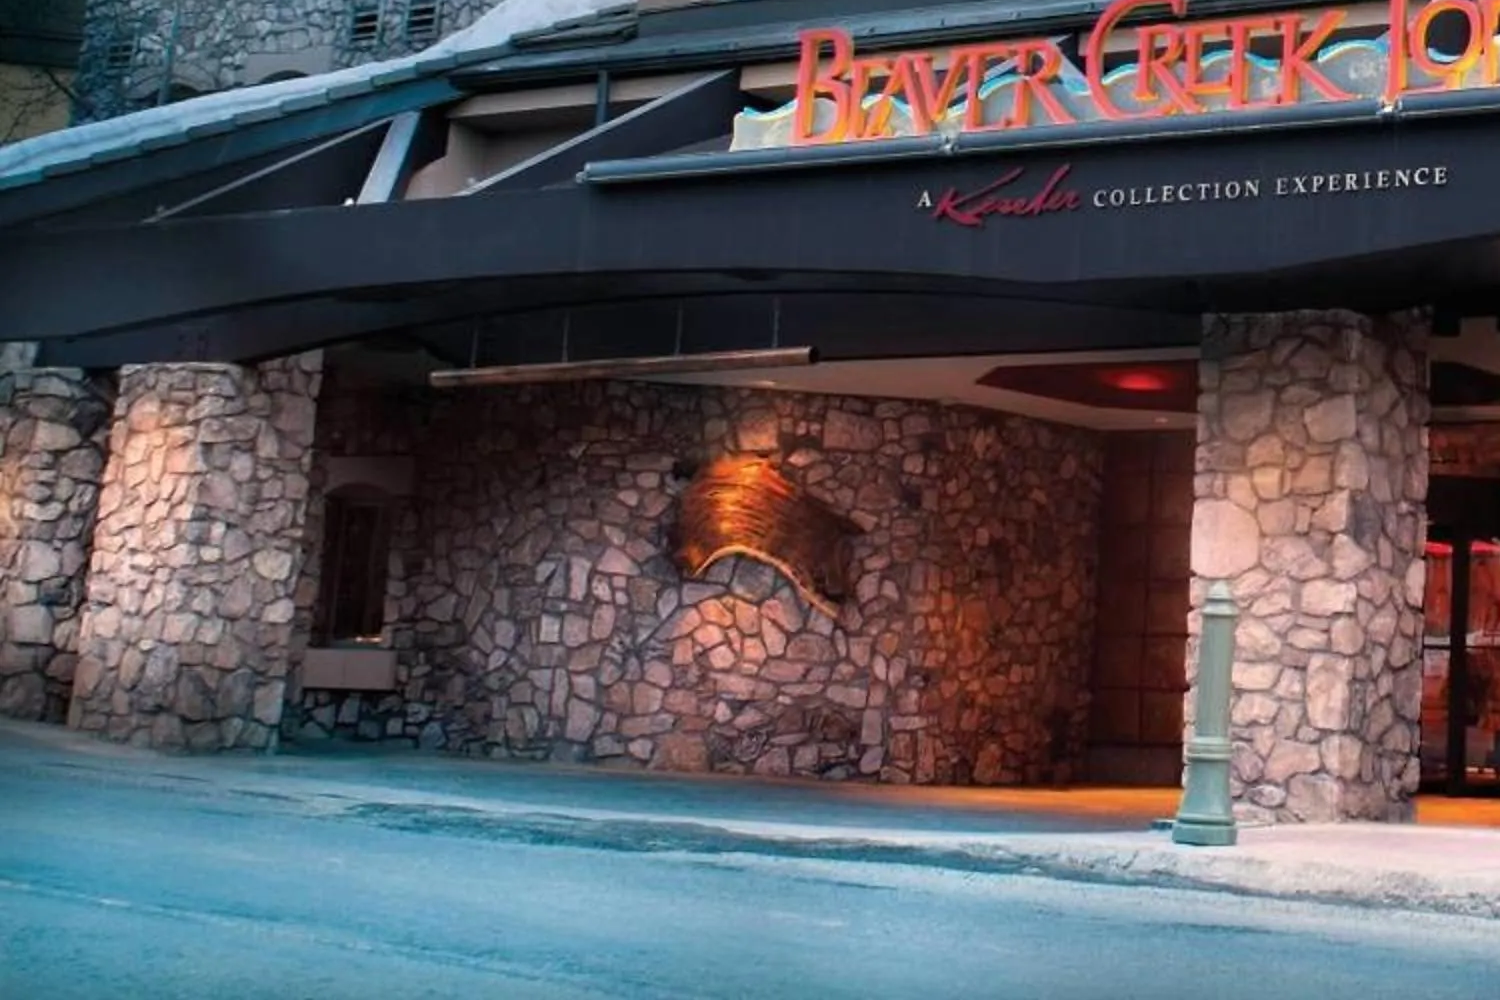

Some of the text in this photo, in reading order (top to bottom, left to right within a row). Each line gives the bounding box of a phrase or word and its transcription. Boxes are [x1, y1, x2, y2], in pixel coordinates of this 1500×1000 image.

[792, 28, 1075, 145] BEAVER
[917, 190, 932, 208] A
[1093, 178, 1260, 207] COLLECTION
[1276, 166, 1448, 196] EXPERIENCE
